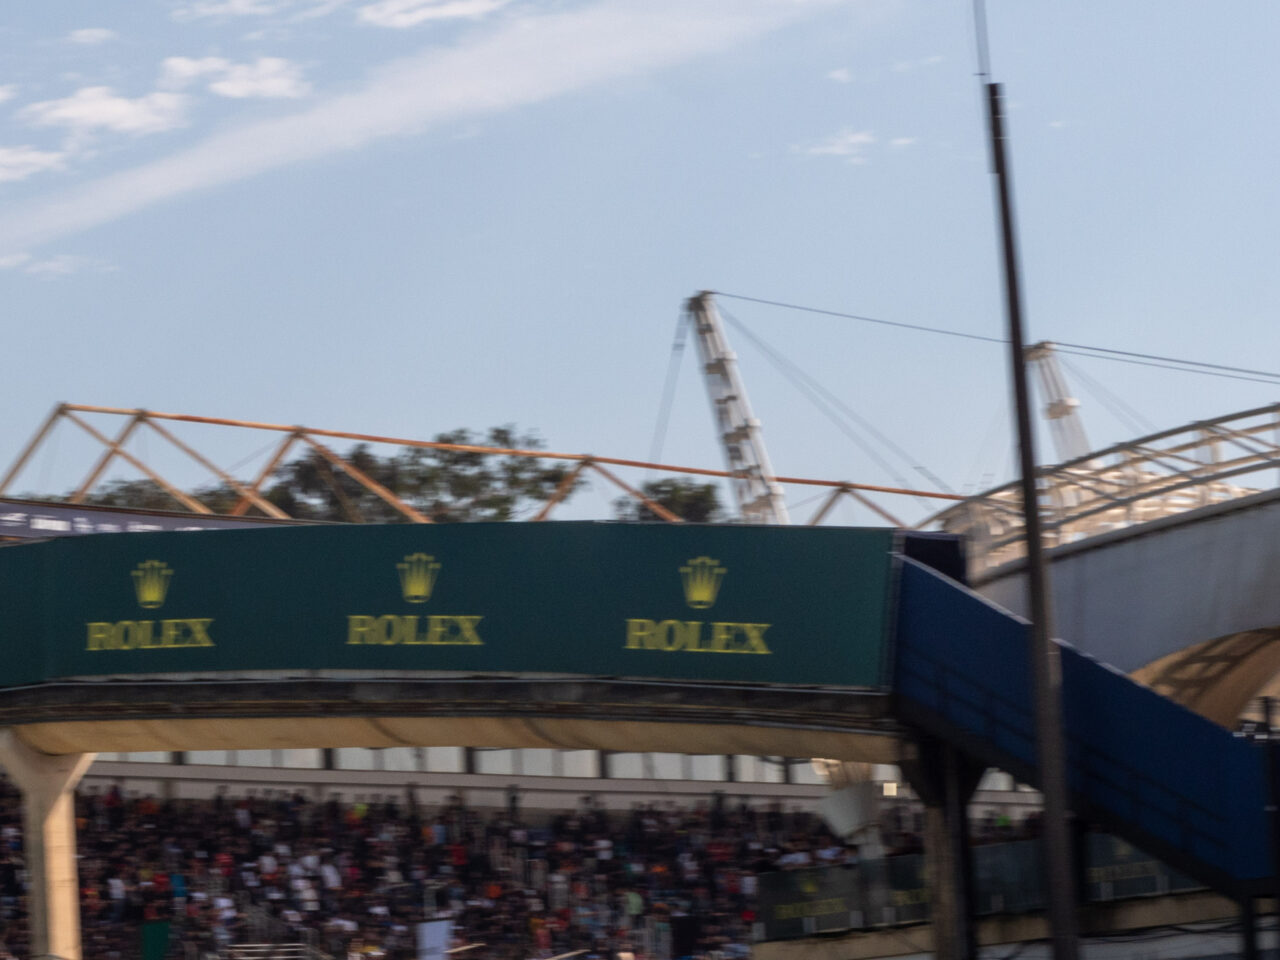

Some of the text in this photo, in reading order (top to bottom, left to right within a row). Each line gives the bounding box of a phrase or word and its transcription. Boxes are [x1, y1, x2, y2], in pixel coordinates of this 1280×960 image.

[87, 617, 214, 651] ROLEX
[348, 614, 484, 646] ROLEX
[626, 617, 772, 655] ROLEX
